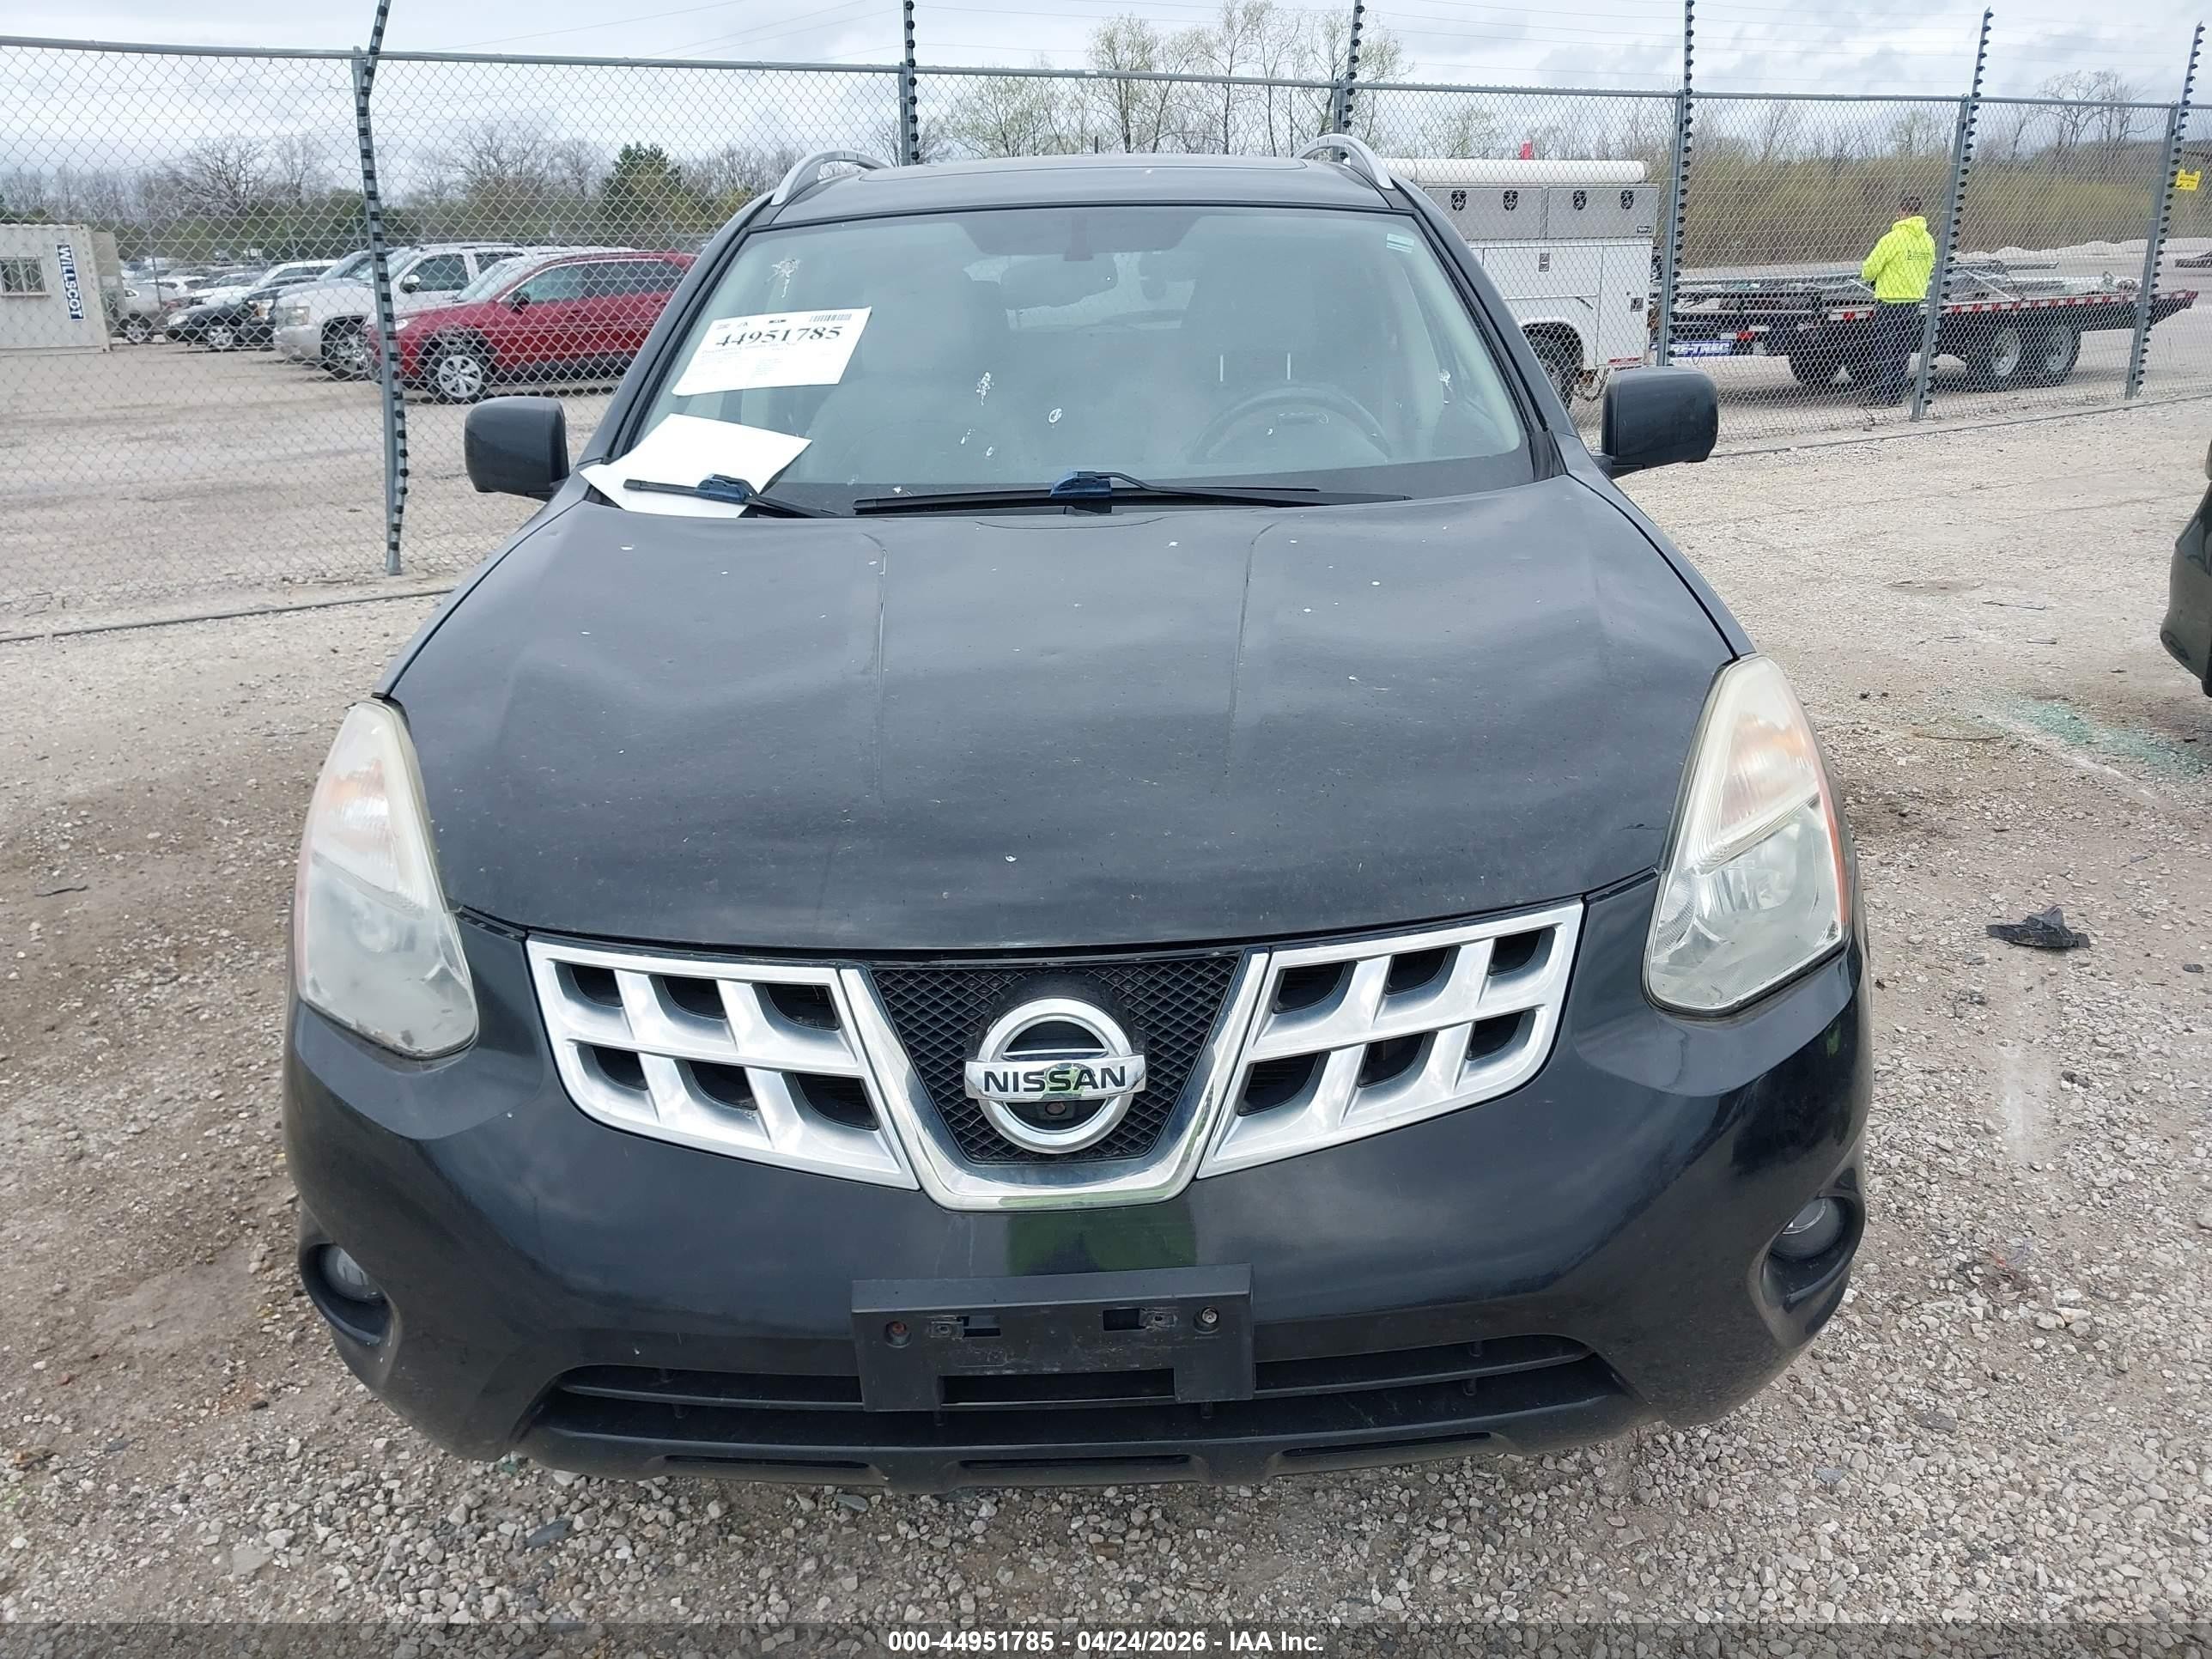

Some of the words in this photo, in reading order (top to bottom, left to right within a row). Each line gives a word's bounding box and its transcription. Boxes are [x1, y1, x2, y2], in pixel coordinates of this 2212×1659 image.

[58, 246, 83, 319] WILLSCOT
[715, 325, 844, 347] 44951785
[983, 1065, 1126, 1094] NISSAN
